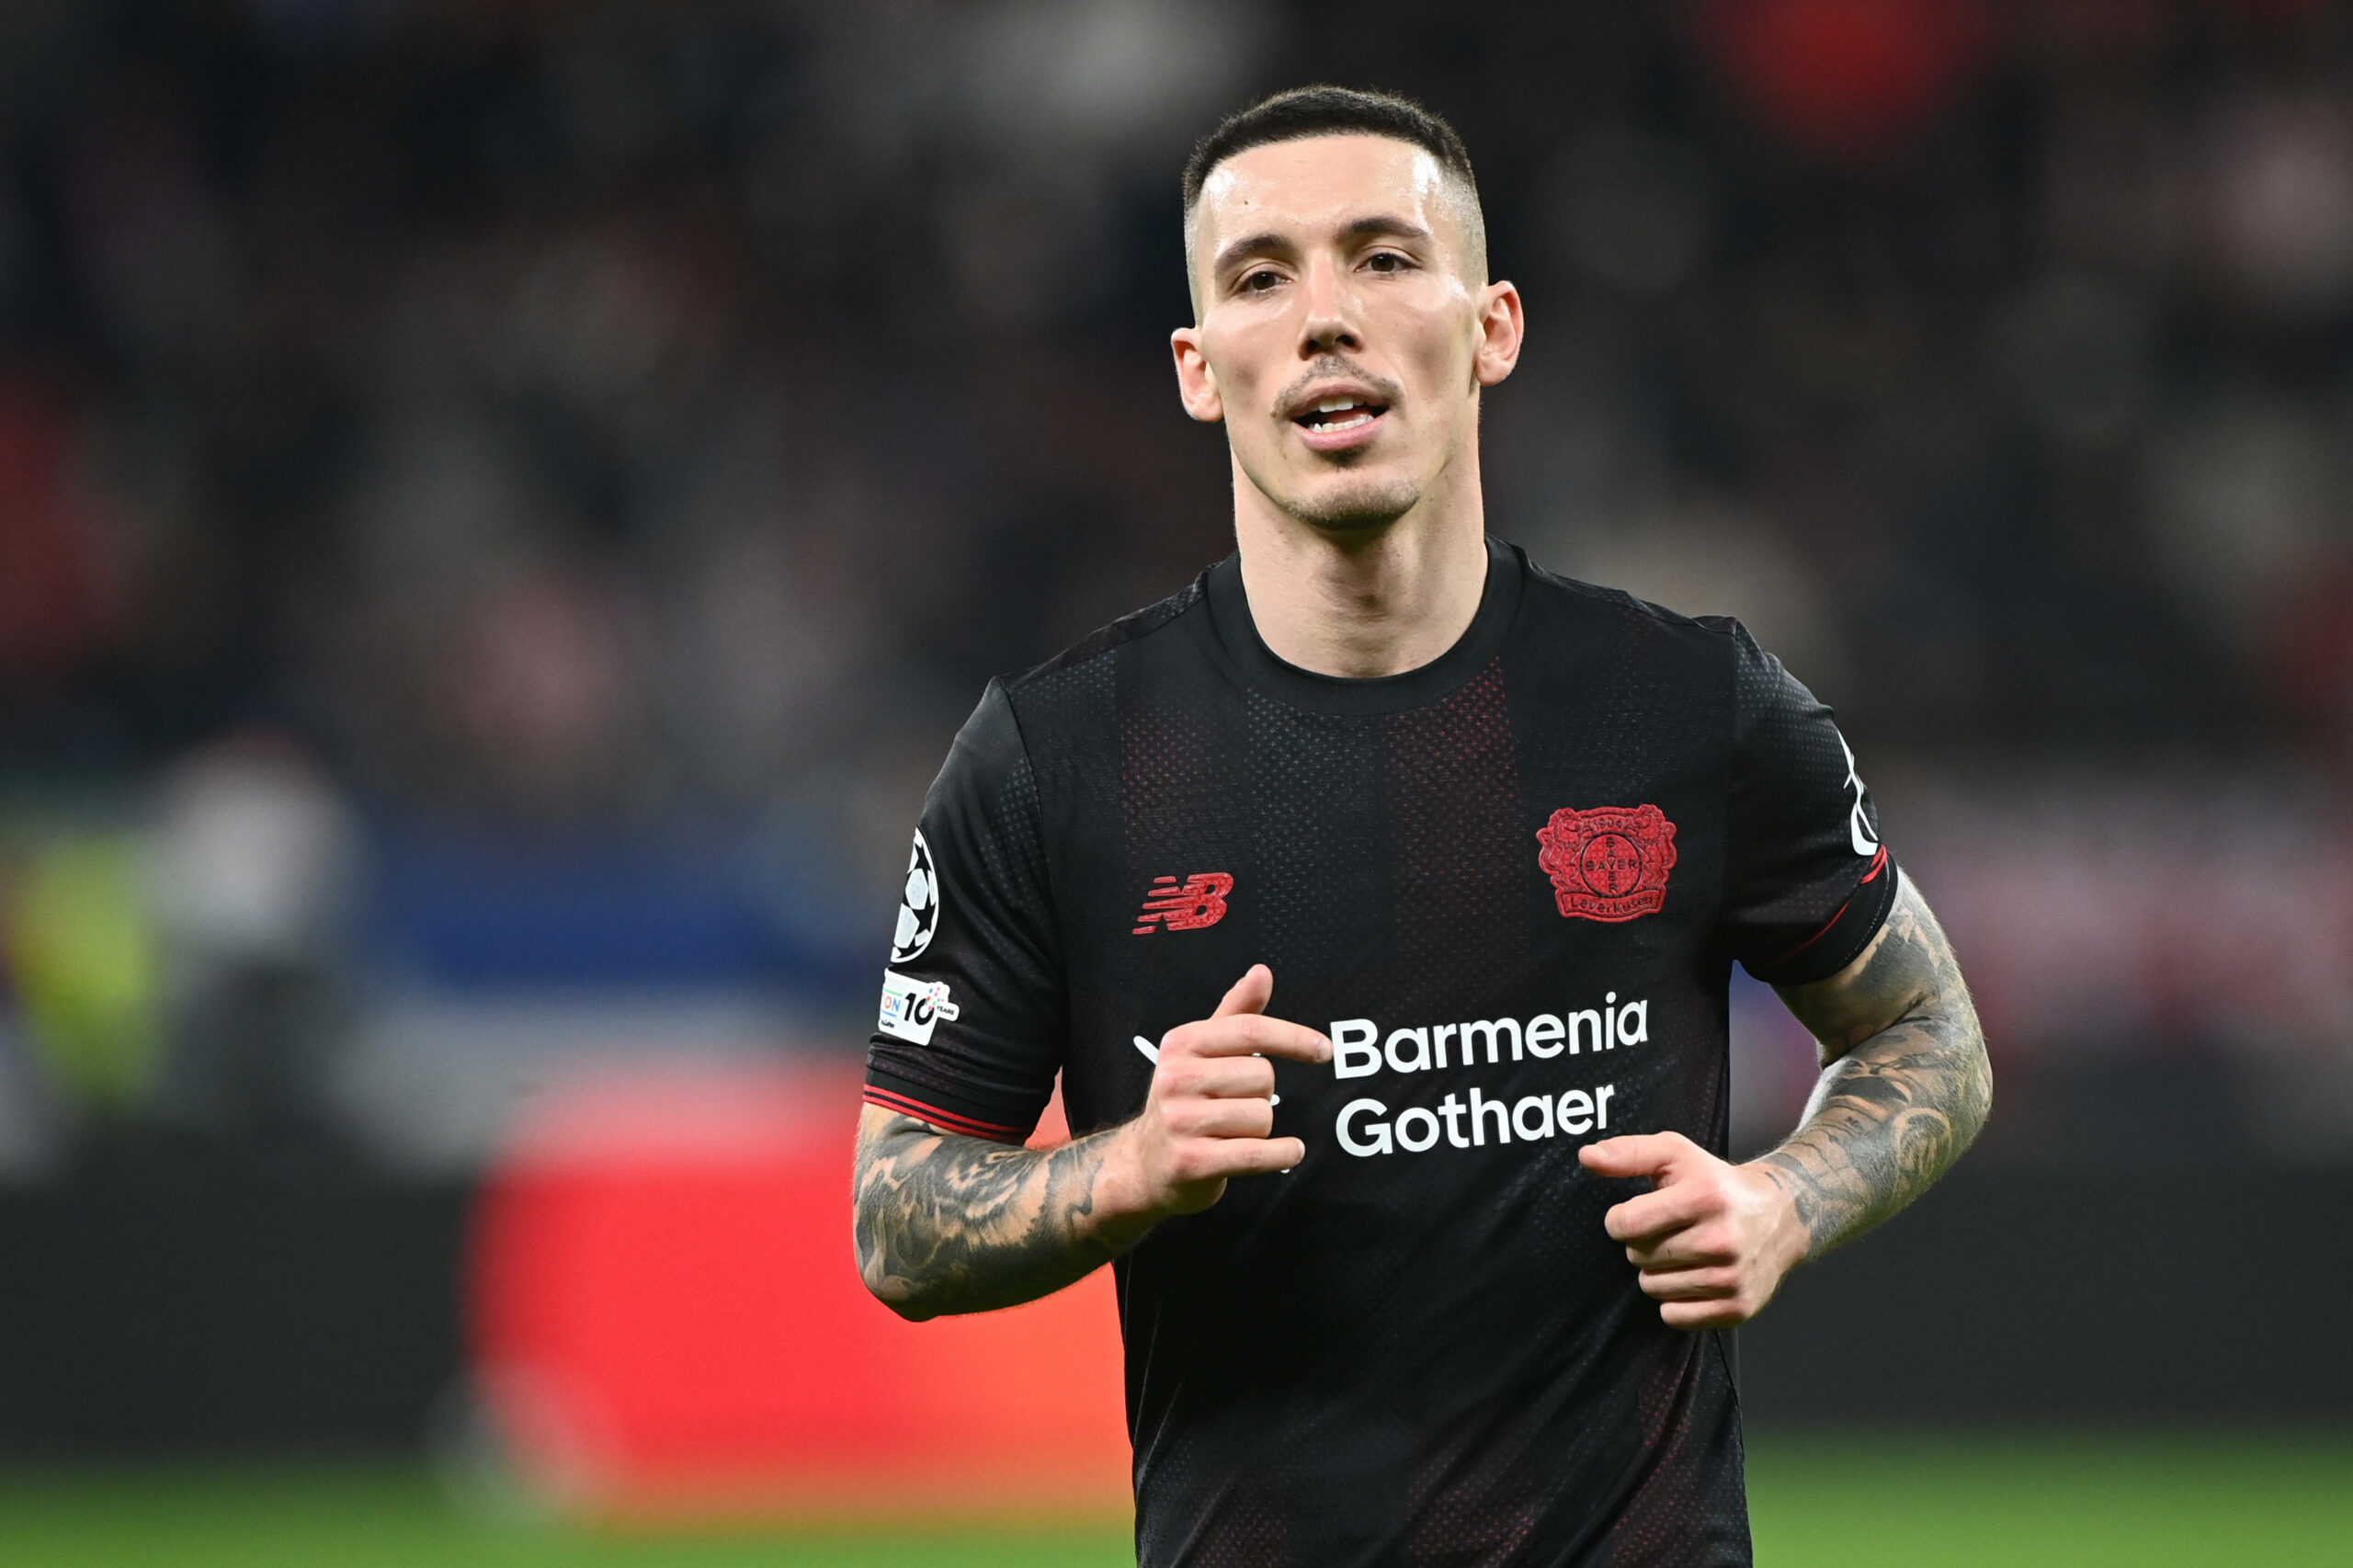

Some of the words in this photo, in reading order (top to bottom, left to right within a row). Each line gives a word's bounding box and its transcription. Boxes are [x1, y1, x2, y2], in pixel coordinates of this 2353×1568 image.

[1586, 858, 1637, 870] BAYER
[1570, 895, 1654, 914] Leverkusen
[904, 993, 934, 1025] 10
[937, 1006, 954, 1015] YEARS
[1330, 991, 1649, 1080] Barmenia
[1336, 1084, 1615, 1157] Gothaer
